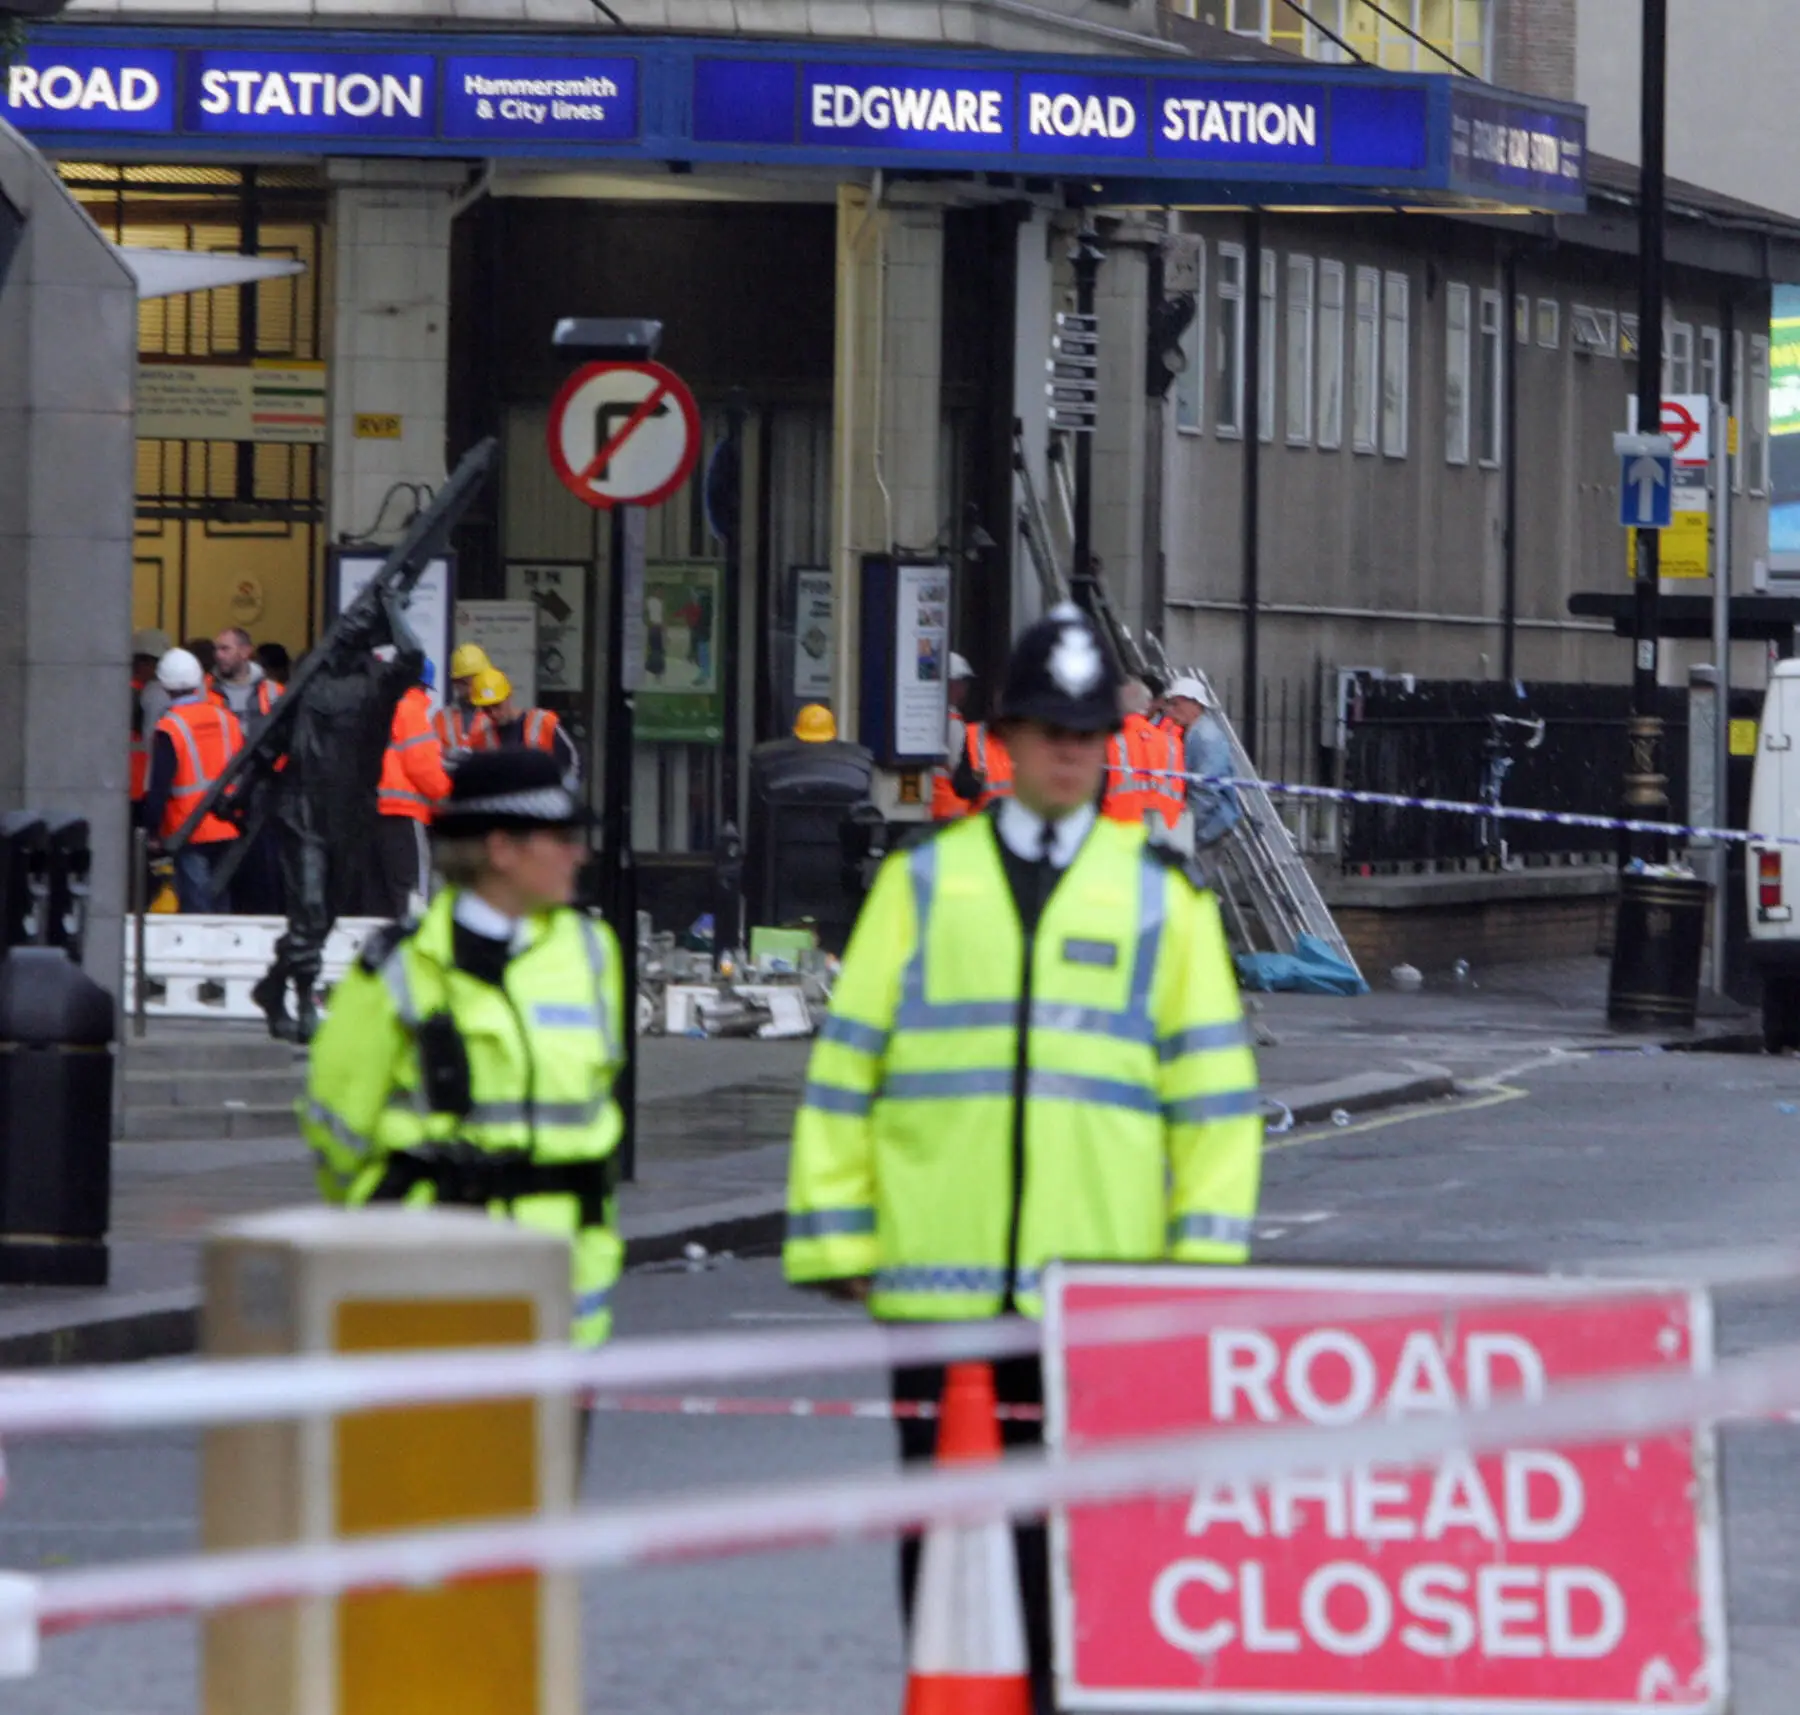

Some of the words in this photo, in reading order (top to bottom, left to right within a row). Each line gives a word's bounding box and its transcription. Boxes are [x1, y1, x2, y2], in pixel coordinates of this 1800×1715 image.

[8, 65, 159, 111] ROAD
[200, 69, 423, 117] STATION
[464, 73, 618, 97] Hammersmith
[476, 98, 495, 119] &
[499, 98, 547, 124] City
[552, 99, 605, 121] lines
[811, 83, 1002, 134] EDGWARE
[1028, 91, 1136, 139] ROAD
[1162, 97, 1316, 147] STATION
[358, 416, 399, 434] RVP
[1207, 1328, 1546, 1428] ROAD
[1185, 1449, 1585, 1543] AHEAD
[1149, 1557, 1628, 1659] CLOSED
